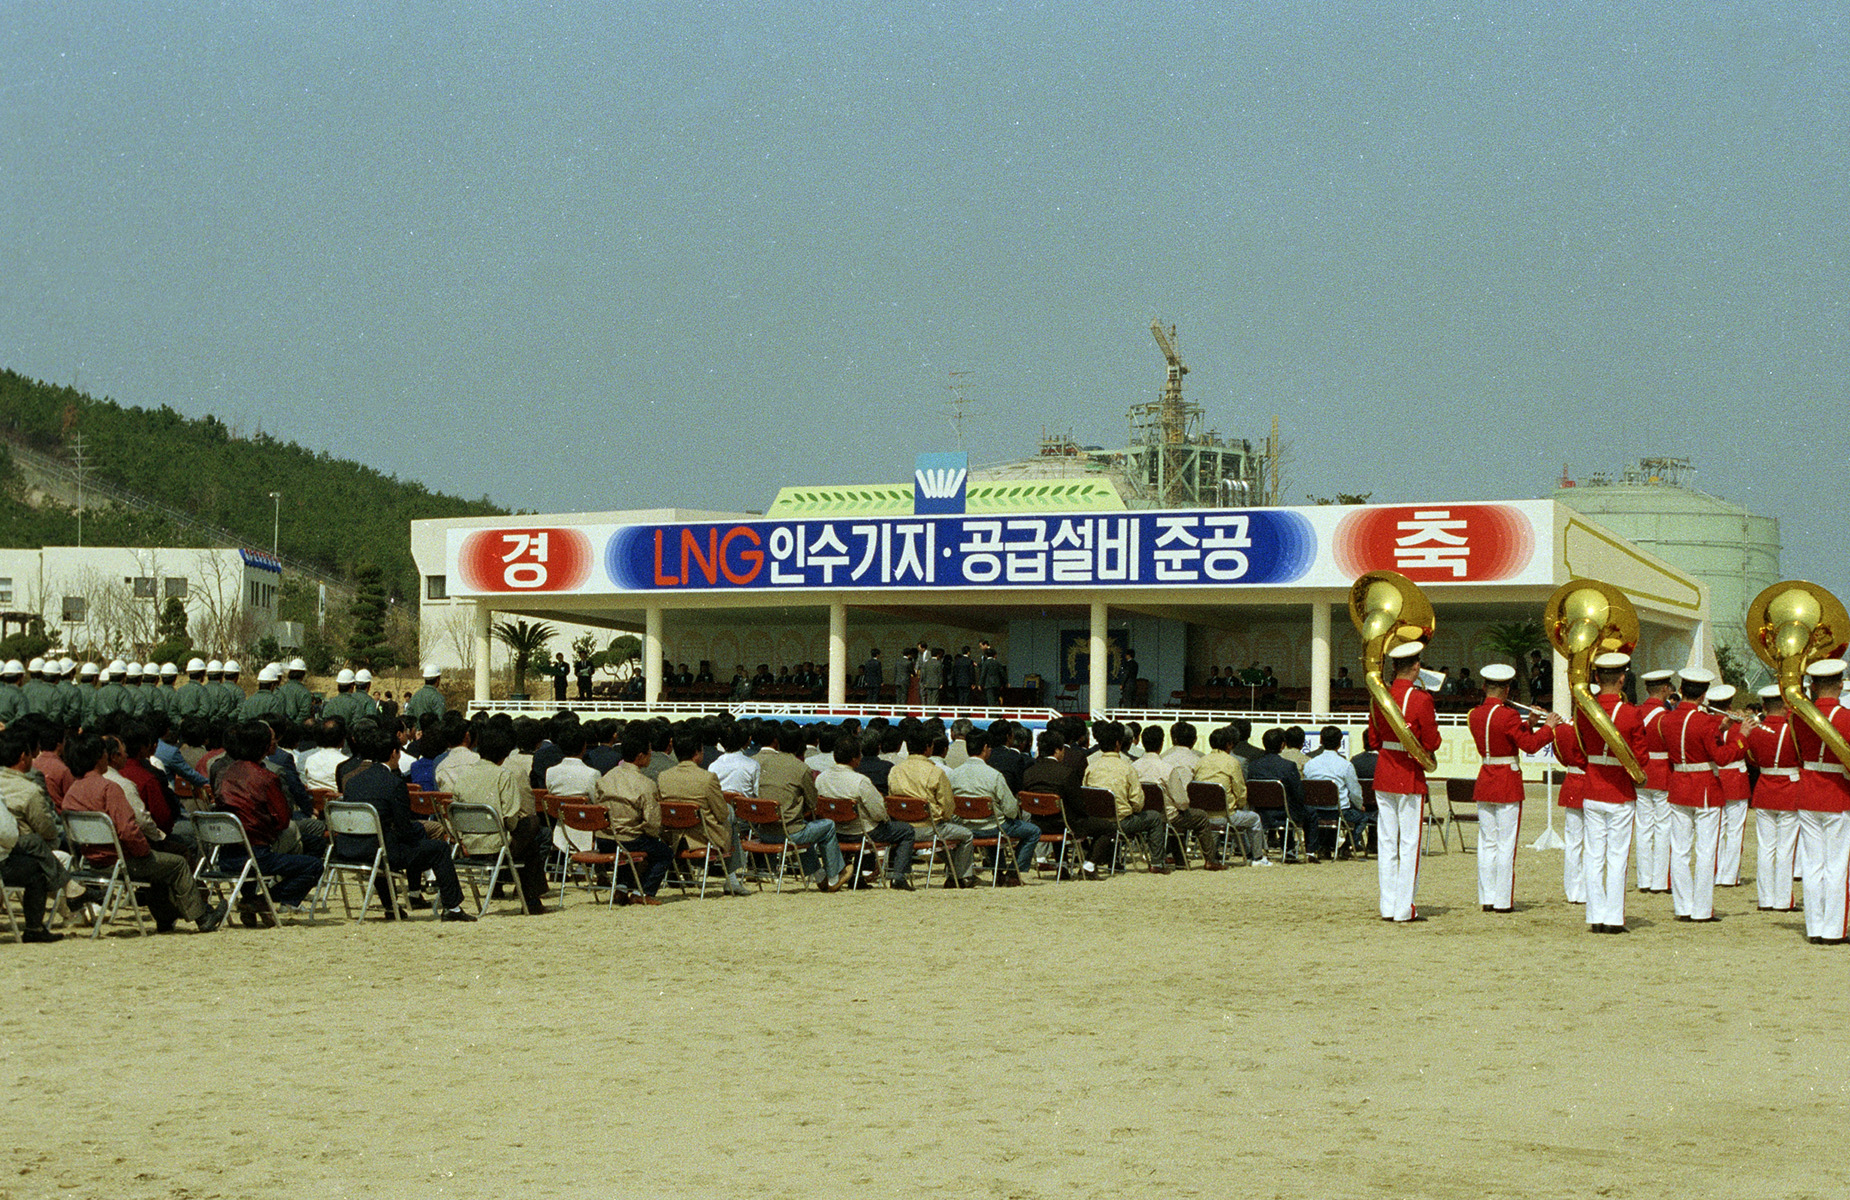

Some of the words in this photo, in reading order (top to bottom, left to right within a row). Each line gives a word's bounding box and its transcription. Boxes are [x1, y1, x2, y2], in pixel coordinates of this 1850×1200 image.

[502, 532, 549, 588] 경
[653, 526, 764, 586] LNG
[1153, 515, 1252, 582] 준공
[1393, 509, 1471, 579] 축
